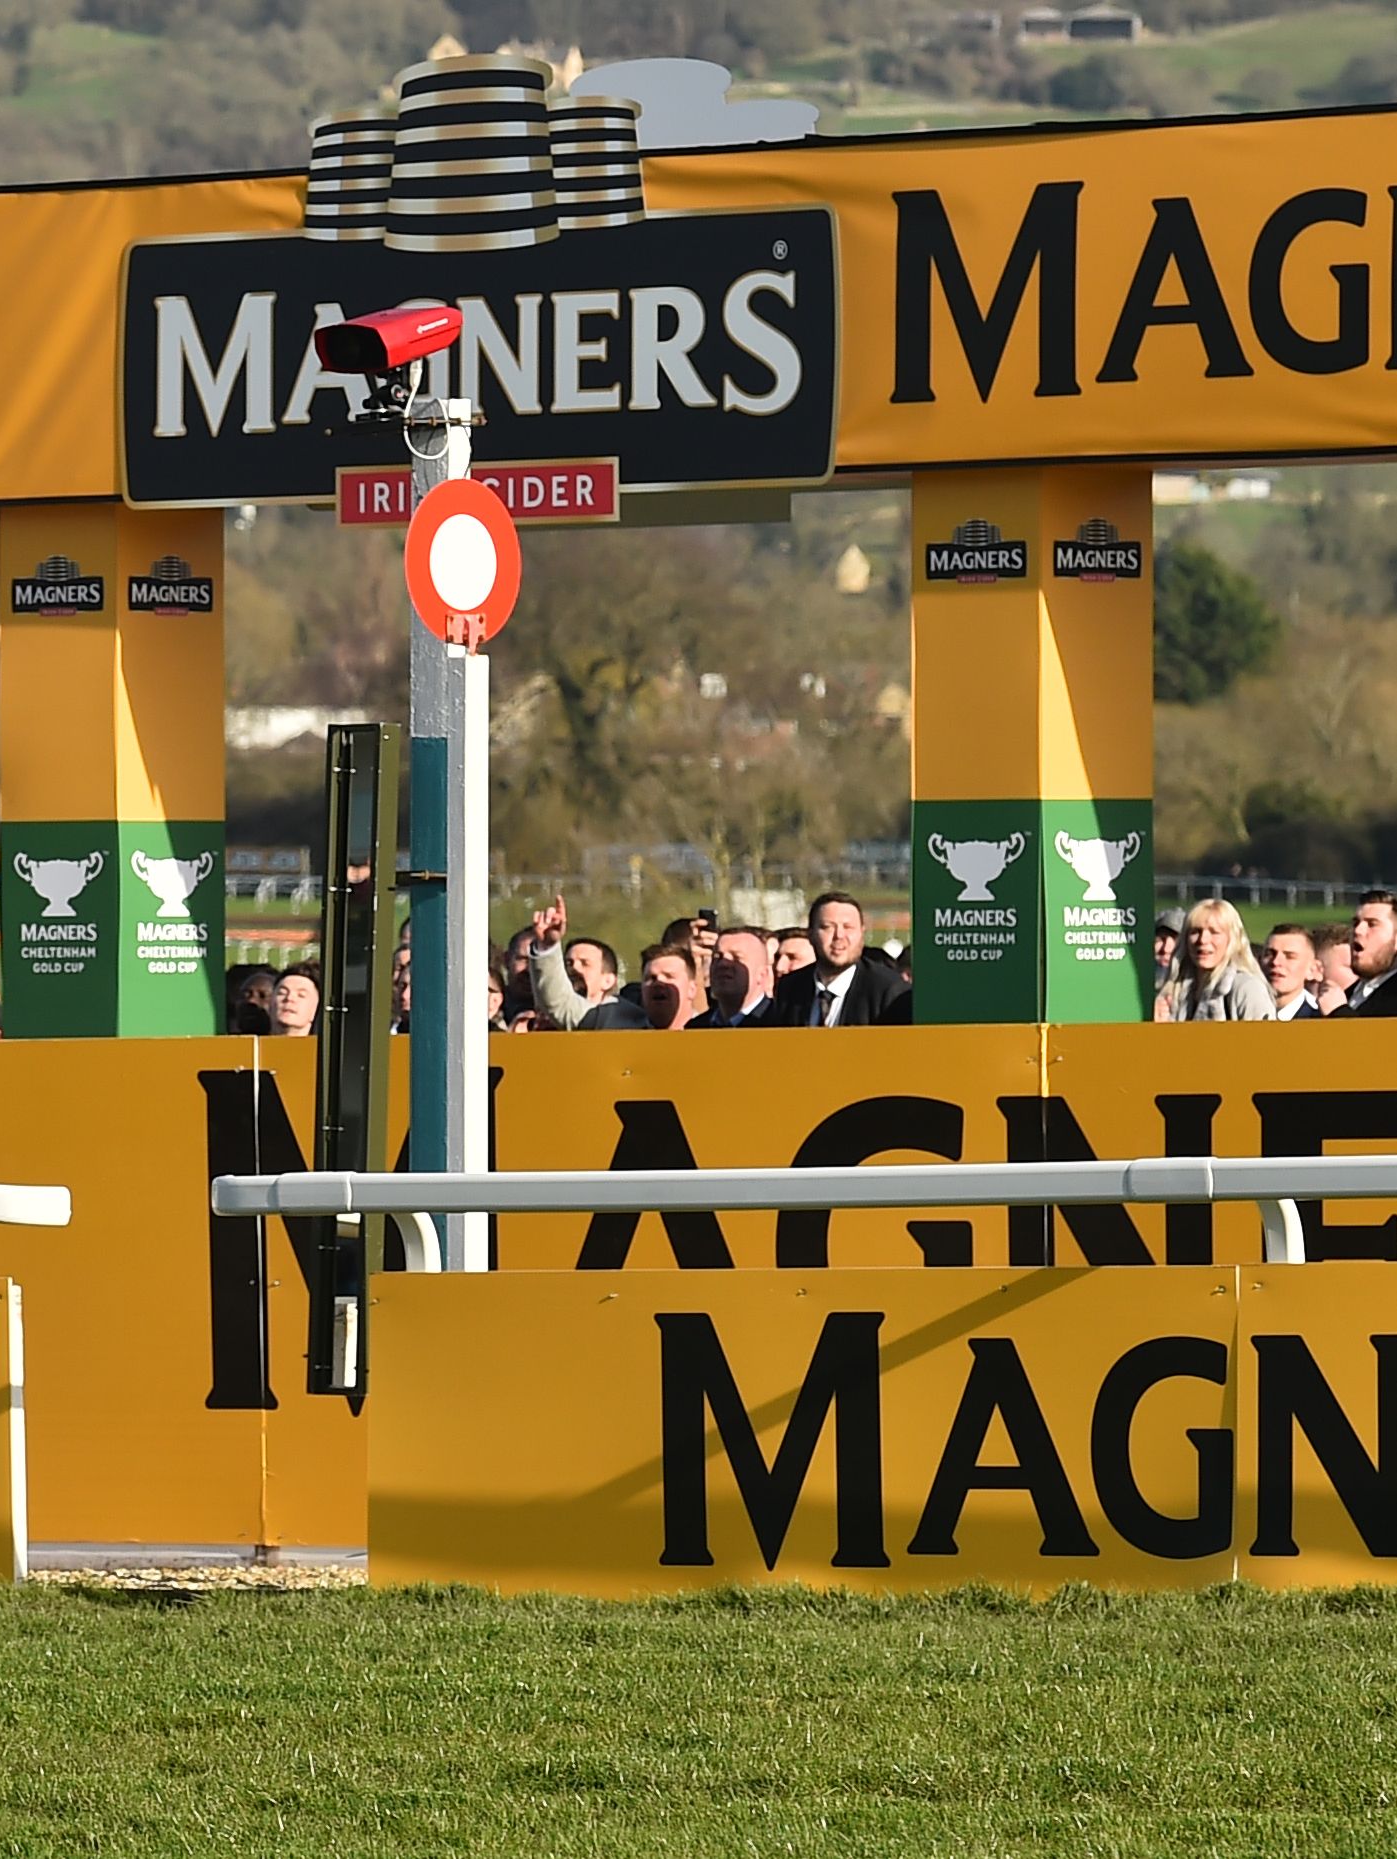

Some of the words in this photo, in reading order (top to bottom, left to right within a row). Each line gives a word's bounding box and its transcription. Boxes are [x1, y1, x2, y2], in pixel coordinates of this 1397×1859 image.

[890, 181, 1397, 404] MAG
[929, 548, 1023, 572] MAGNERS
[1056, 547, 1138, 570] MAGNERS
[15, 583, 101, 605] MAGNERS
[131, 582, 210, 604] MAGNERS
[934, 908, 1017, 927] MAGNERS
[1063, 906, 1137, 927] MAGNERS
[20, 923, 98, 942] MAGNERS
[137, 922, 208, 942] MAGNERS
[934, 932, 1016, 945] CHELTENHAM
[1064, 931, 1136, 945] CHELTENHAM
[21, 947, 96, 959] CHELTENHAM
[137, 945, 207, 958] CHELTENHAM
[947, 950, 978, 961] GOLD
[980, 950, 1003, 961] CUP
[1075, 948, 1104, 961] GOLD
[1105, 948, 1126, 961] CUP
[32, 962, 61, 973] GOLD
[63, 962, 85, 973] CUP
[147, 961, 176, 973] GOLD
[177, 961, 198, 973] CUP
